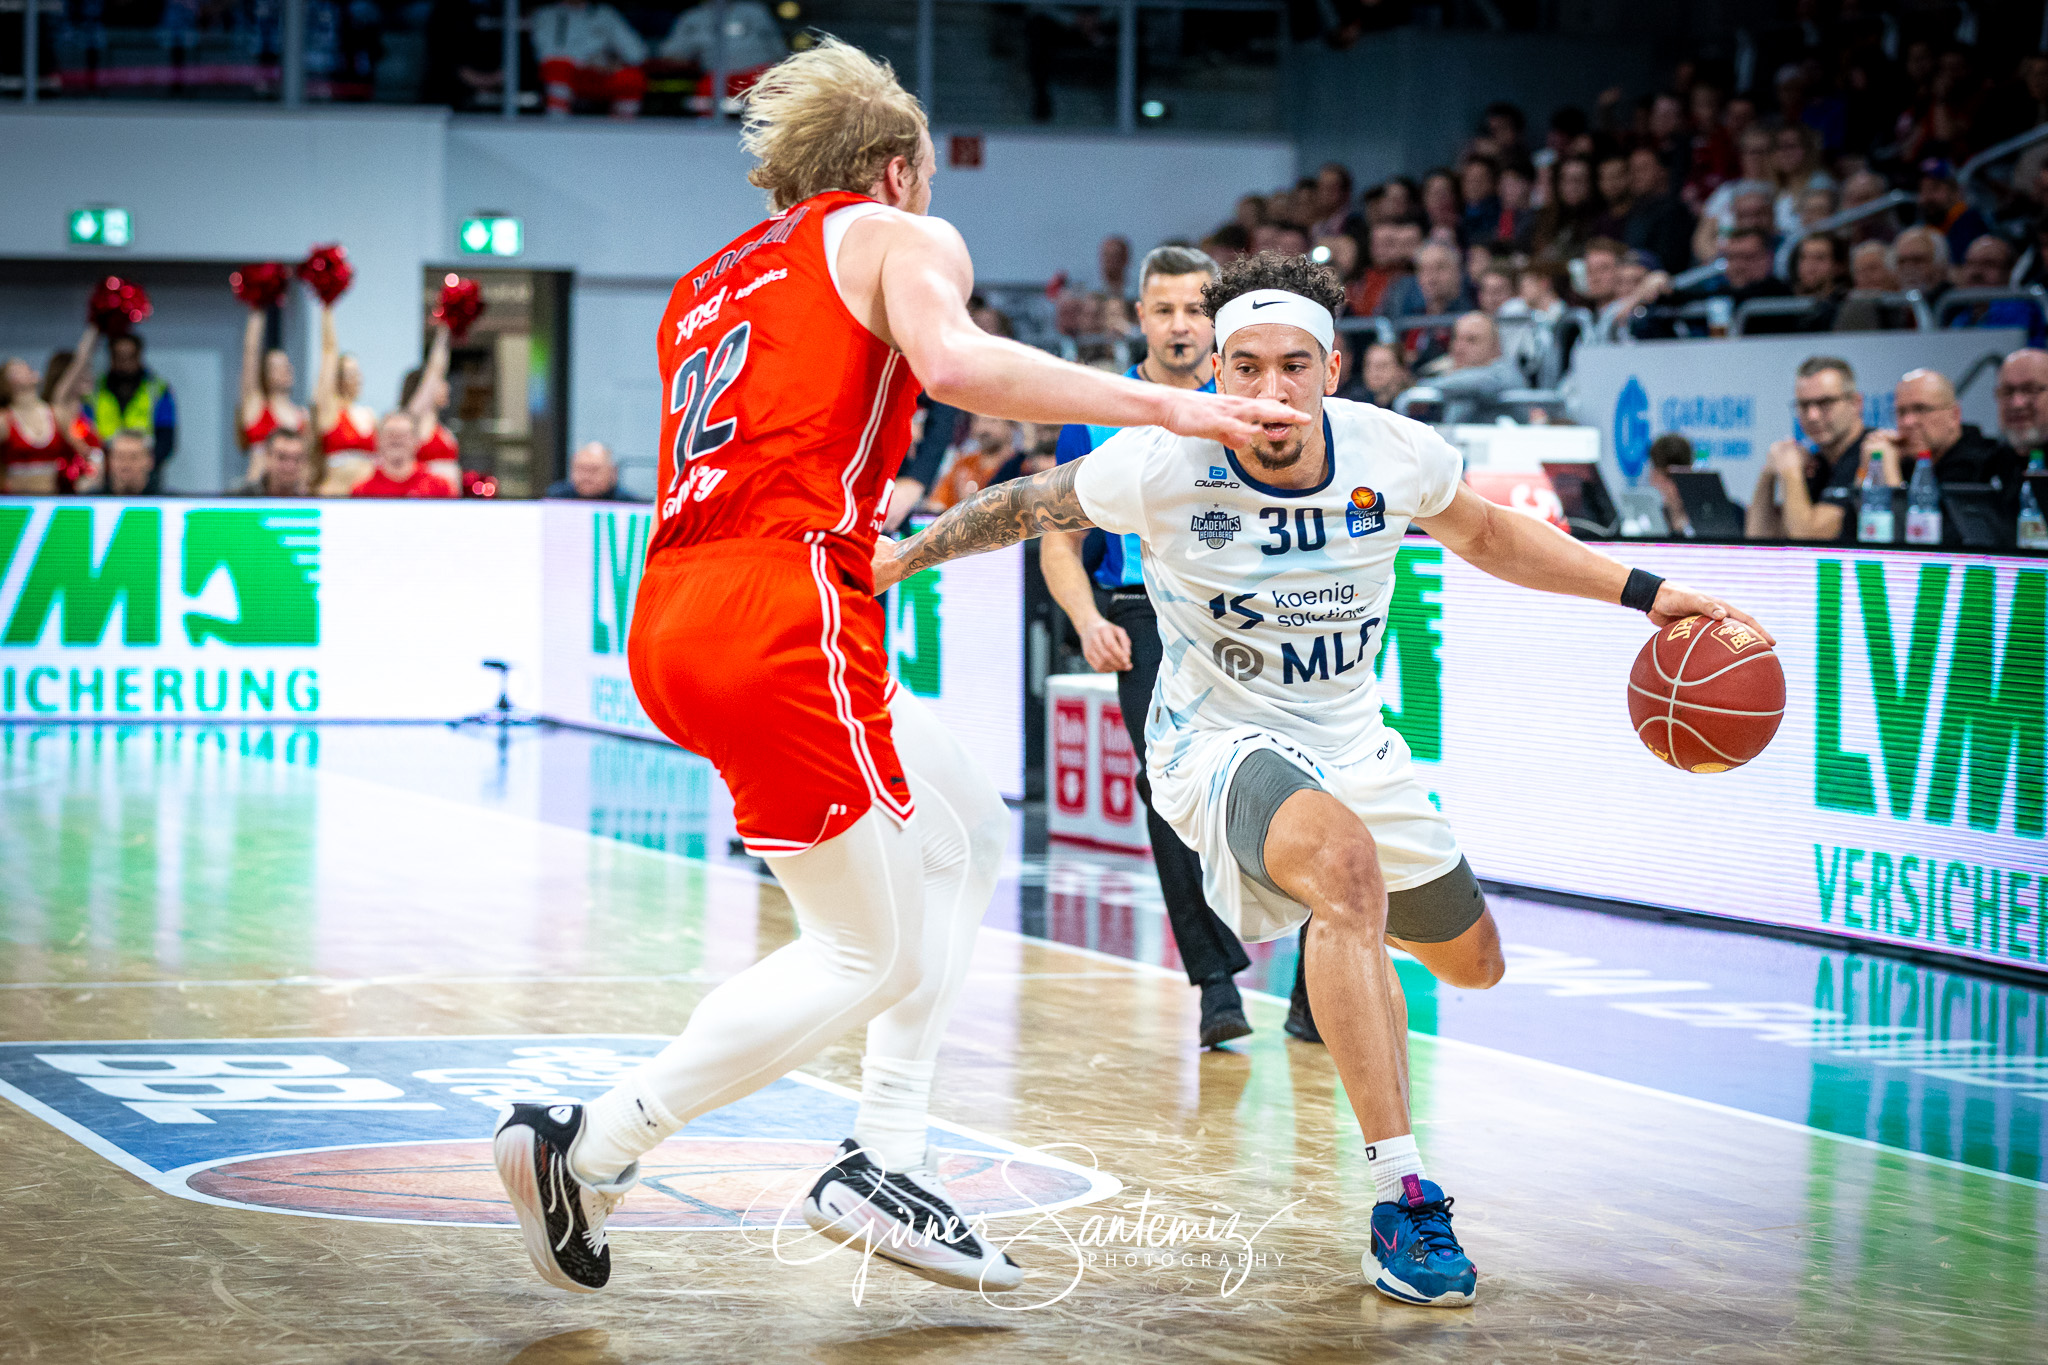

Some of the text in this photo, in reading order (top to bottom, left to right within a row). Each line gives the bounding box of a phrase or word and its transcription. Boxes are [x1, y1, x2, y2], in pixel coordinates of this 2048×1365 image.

[675, 286, 728, 345] xpd
[671, 320, 751, 494] 22
[1192, 518, 1240, 531] ACADEMICS
[1200, 531, 1233, 540] HEIDELBERG
[1259, 507, 1327, 556] 30
[1352, 516, 1381, 534] BBL
[1730, 630, 1757, 650] BBL
[3, 666, 320, 712] ICHERUNG
[1814, 558, 2046, 839] LVM
[35, 1053, 447, 1124] BBL
